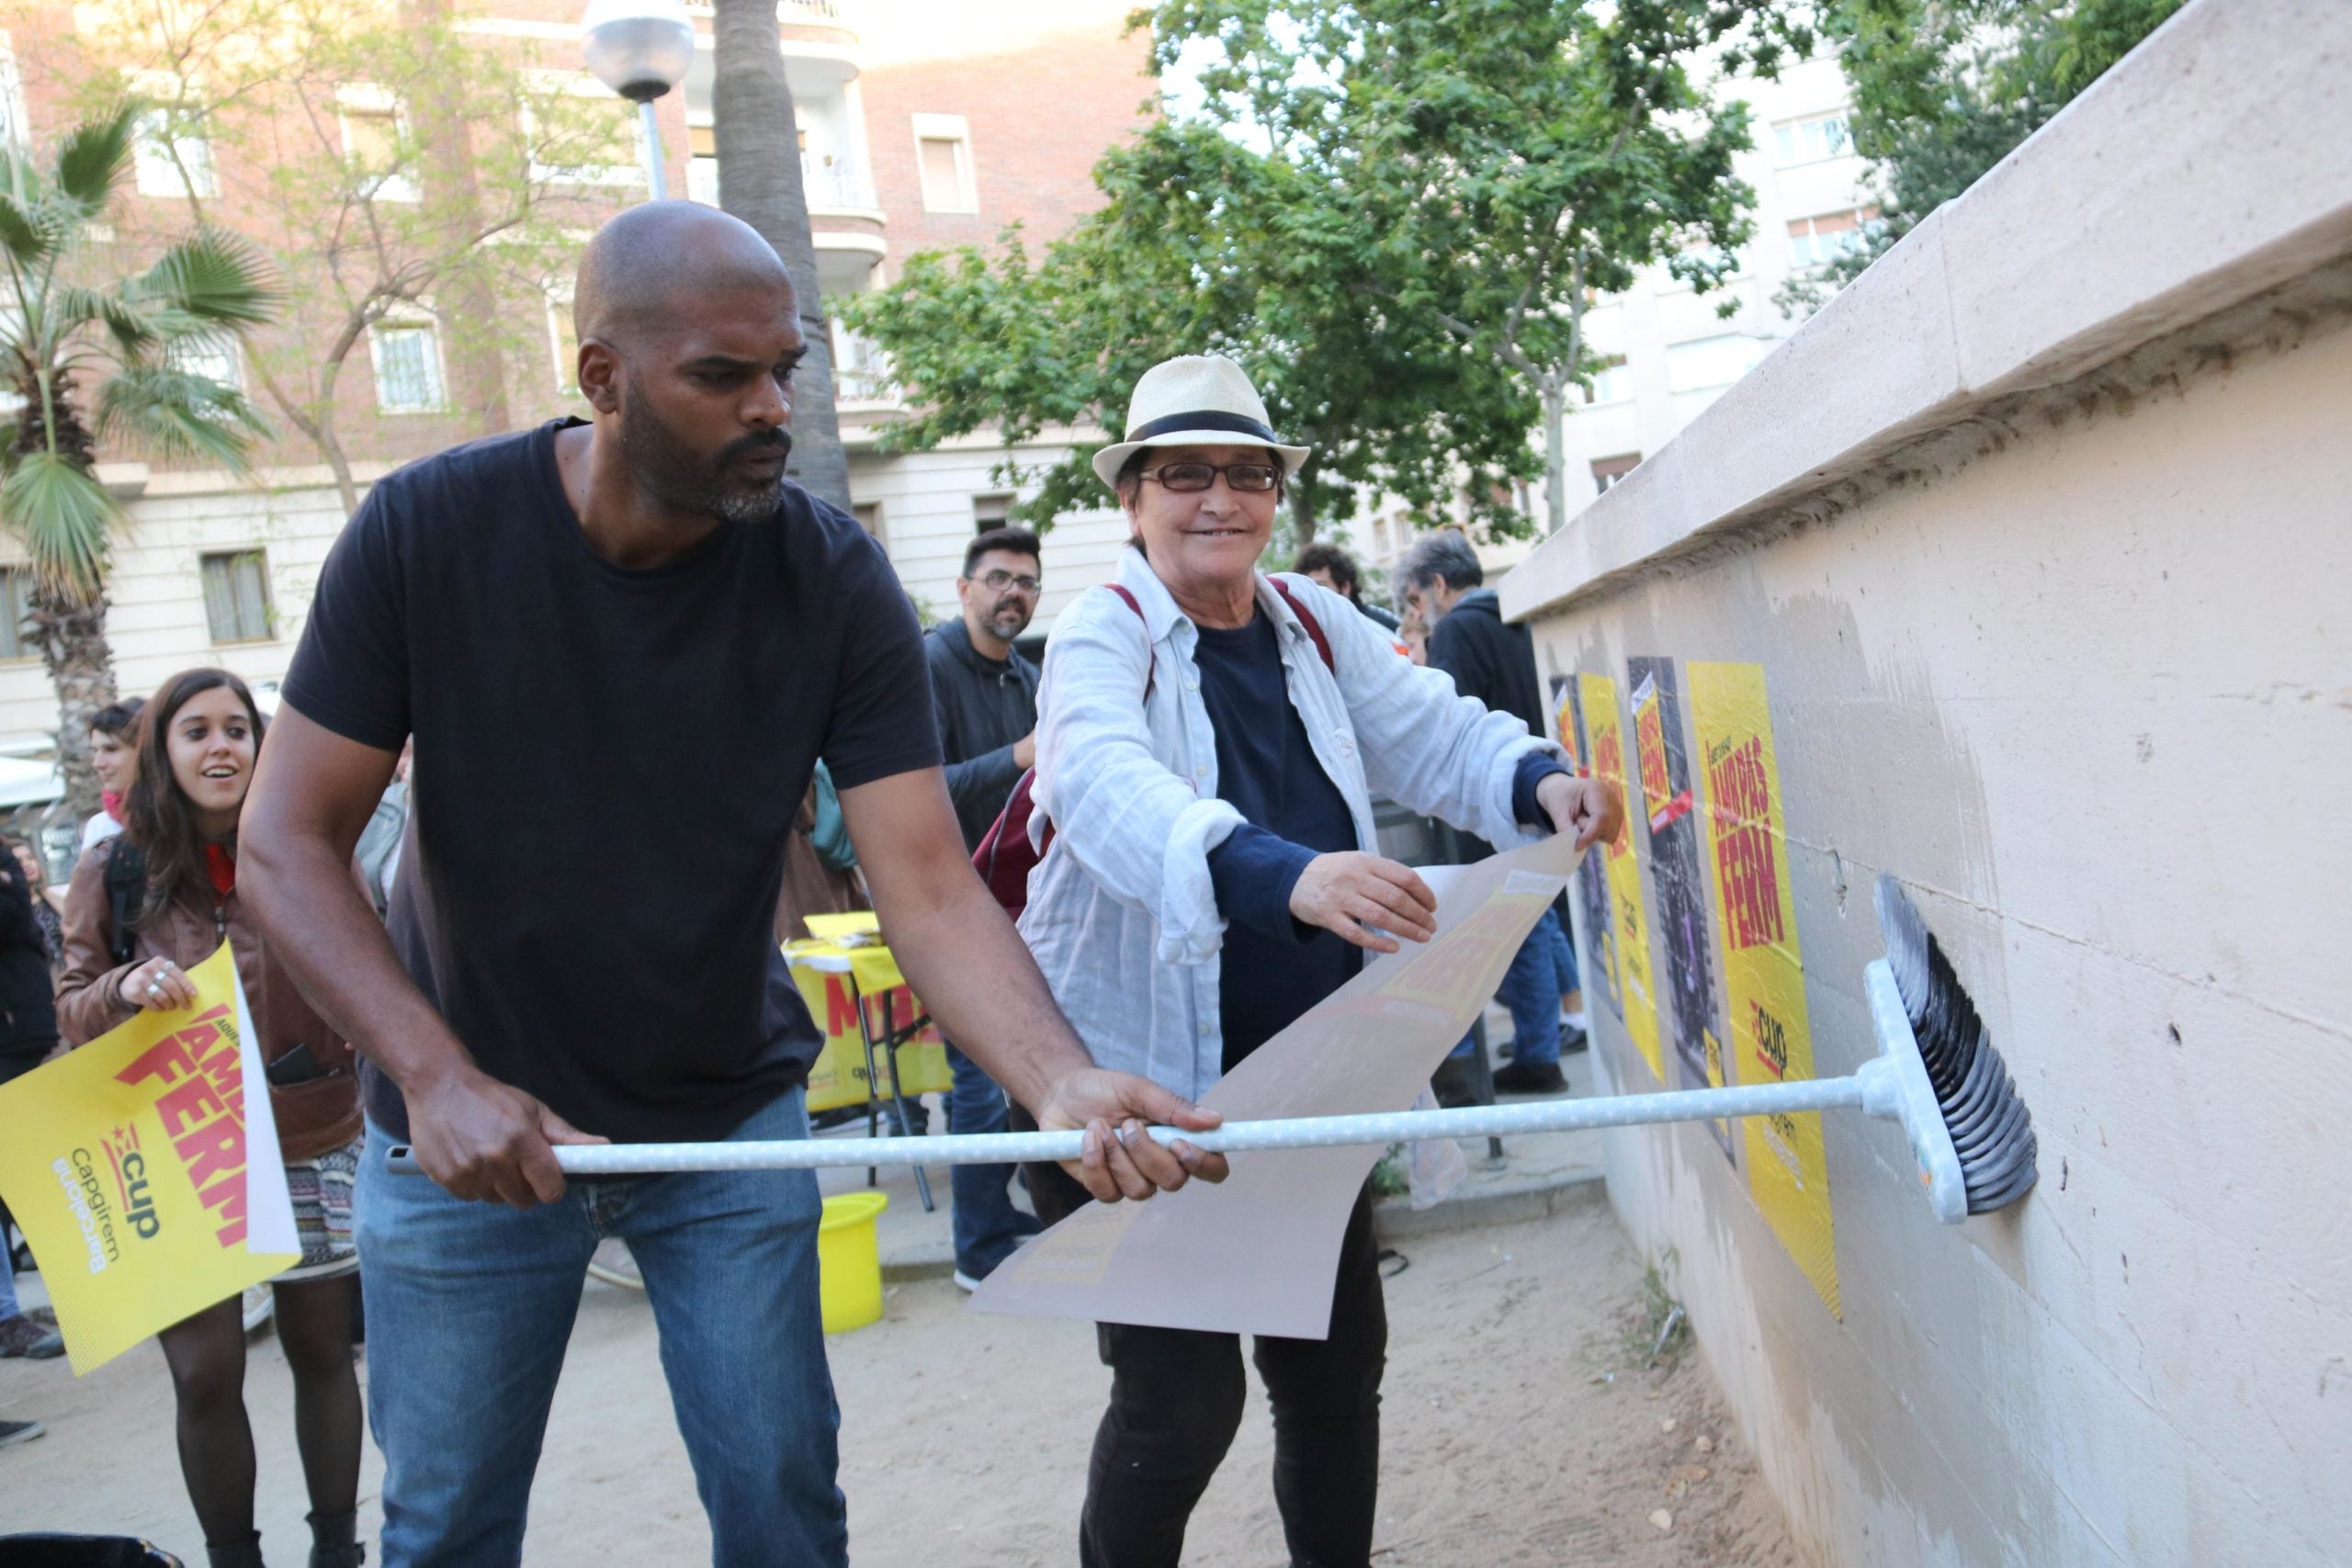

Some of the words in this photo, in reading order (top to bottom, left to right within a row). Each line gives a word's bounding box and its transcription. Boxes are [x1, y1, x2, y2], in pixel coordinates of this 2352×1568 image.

[1717, 817, 1785, 950] FERM
[1758, 1007, 1788, 1081] cup
[112, 1034, 248, 1249] FERM
[122, 1152, 160, 1238] cup
[51, 1157, 107, 1275] Barcelona
[72, 1147, 119, 1262] Capgirem
